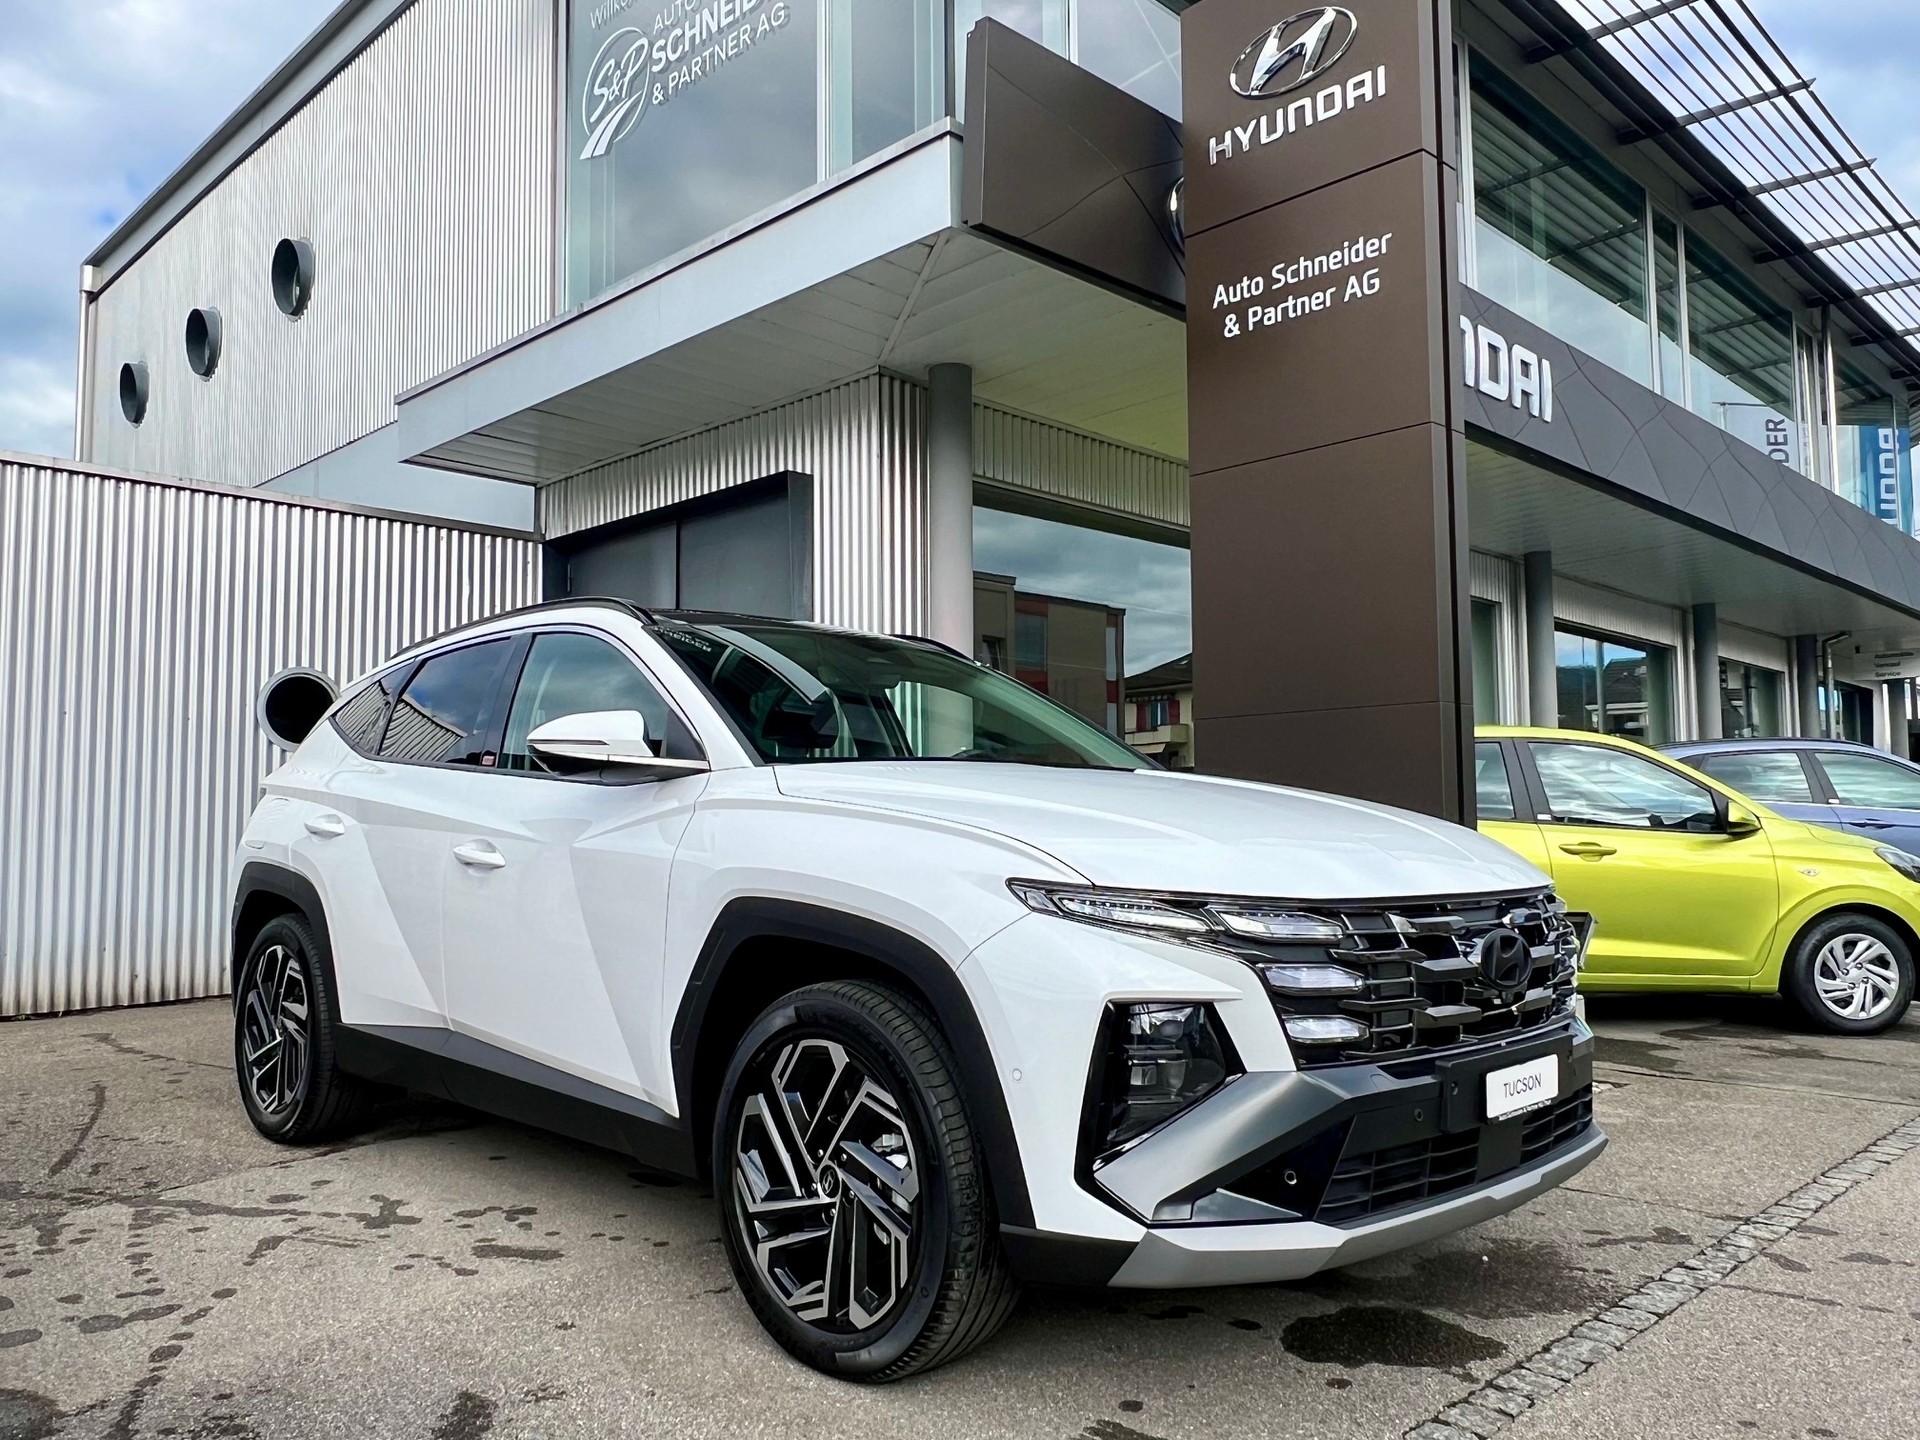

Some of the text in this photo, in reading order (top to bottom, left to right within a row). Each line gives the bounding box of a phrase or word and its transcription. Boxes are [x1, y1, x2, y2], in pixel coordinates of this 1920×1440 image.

[652, 2, 785, 105] & PARTNER AG
[653, 0, 695, 35] AUTO
[1209, 65, 1386, 165] HYUNDAI
[1212, 232, 1393, 310] Auto Schneider
[1223, 267, 1380, 338] & Partner AG
[1503, 1073, 1542, 1098] TUCSON
